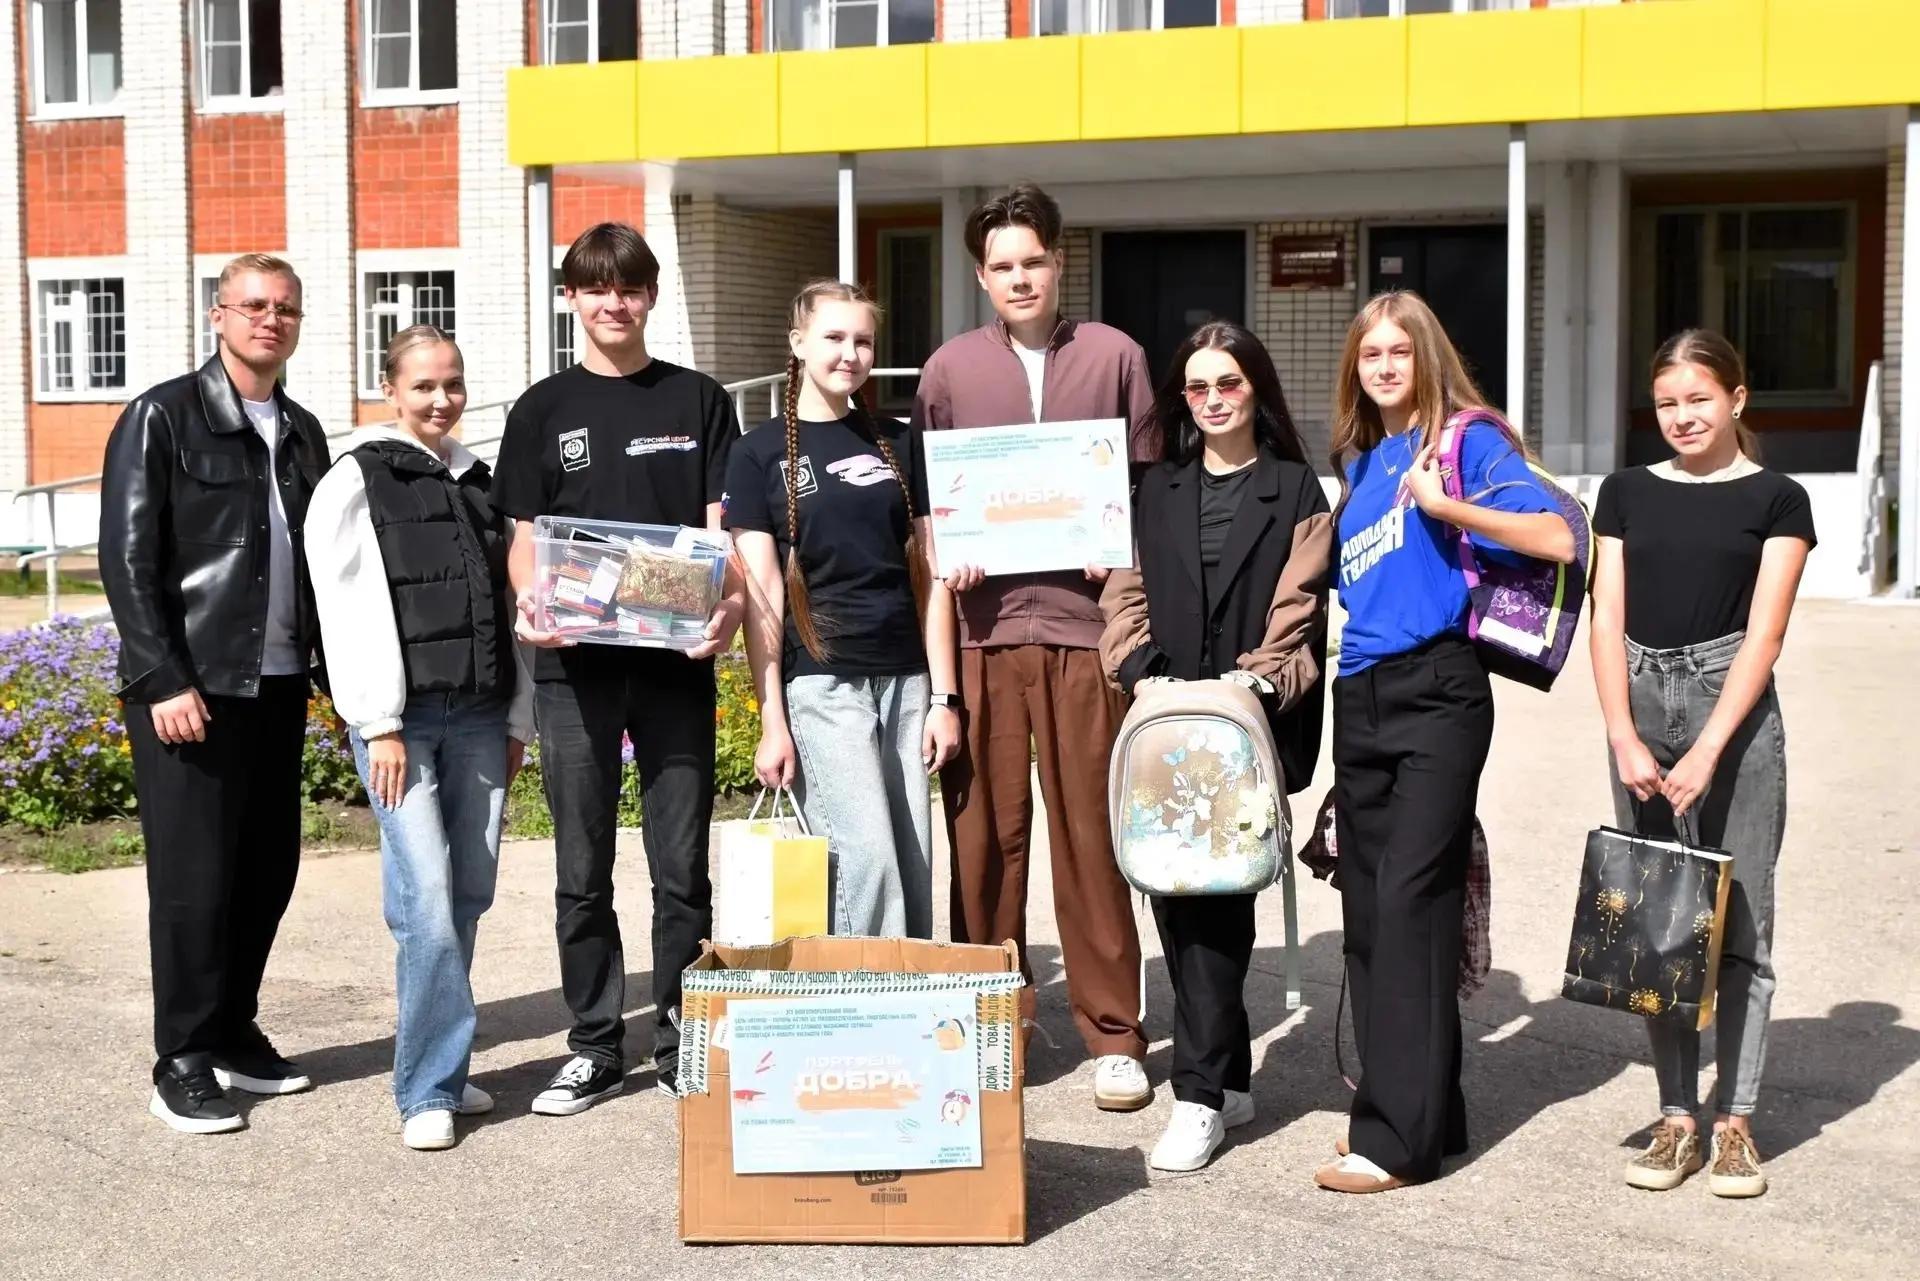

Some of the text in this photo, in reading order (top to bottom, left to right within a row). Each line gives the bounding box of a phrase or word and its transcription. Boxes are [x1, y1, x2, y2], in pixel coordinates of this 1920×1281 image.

[718, 971, 752, 983] ТОВАРЫ
[770, 971, 795, 984] ДОМА
[797, 971, 805, 982] И
[806, 971, 838, 983] ШКОЛЫ
[987, 993, 1000, 1011] ДЛЯ
[682, 1014, 695, 1047] ШКОЛЫ
[986, 1012, 998, 1048] ТОВАРЫ
[795, 1070, 915, 1096] ДОБРА
[985, 1065, 999, 1090] ДОМА
